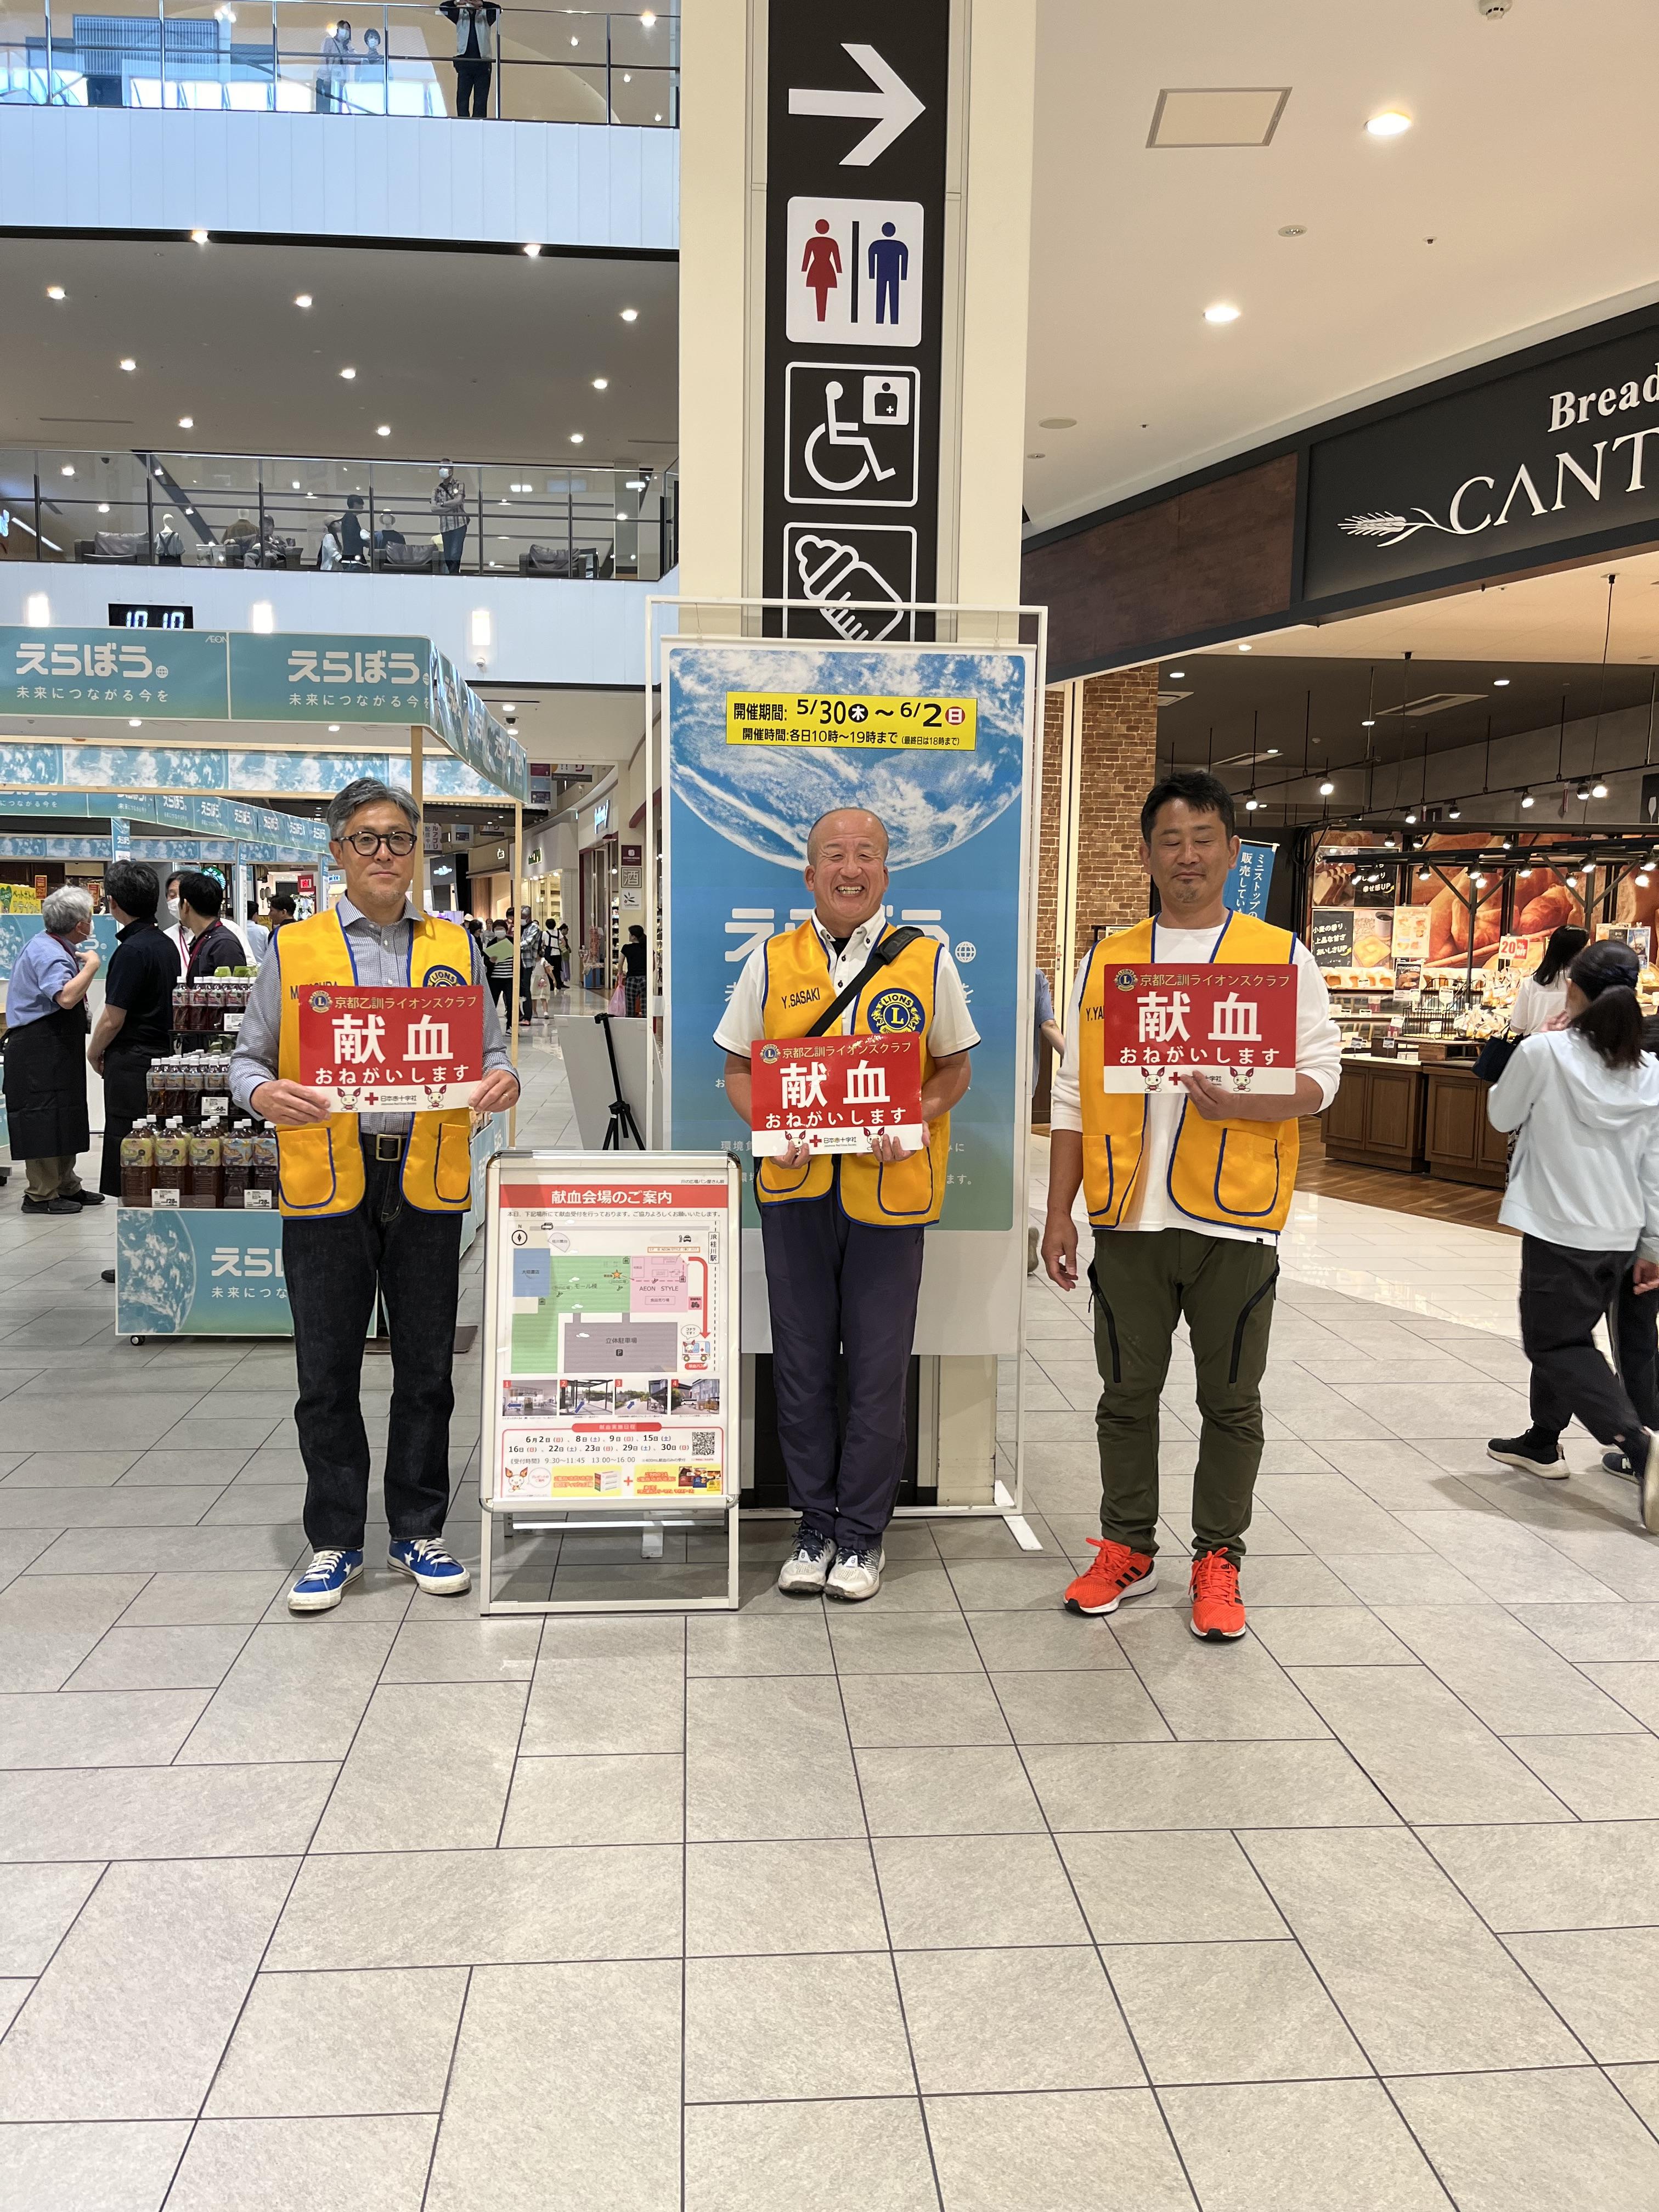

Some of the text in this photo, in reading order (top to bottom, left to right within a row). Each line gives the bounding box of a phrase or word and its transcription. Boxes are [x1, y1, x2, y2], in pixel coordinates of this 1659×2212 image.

[1548, 363, 1659, 432] Bread
[16, 686, 168, 702] 未来につながる今を
[1236, 852, 1253, 913] 販売してい
[1501, 940, 1516, 954] 20
[431, 972, 455, 983] LIONS
[1139, 974, 1291, 987] 京都乙訓ライオンズクラブ
[334, 995, 477, 1010] 京都乙訓ライオンズクラブ
[781, 987, 821, 1009] Y.SASAKI
[883, 995, 911, 1006] LIONS
[782, 1041, 911, 1059] 京都乙訓ライオンズクラブ
[1119, 1046, 1280, 1065] おねがいします
[315, 1064, 469, 1085] おねがいします
[765, 1107, 907, 1130] おねがいします
[551, 1189, 672, 1204] 献血会場のご案内
[211, 1247, 284, 1277] えら
